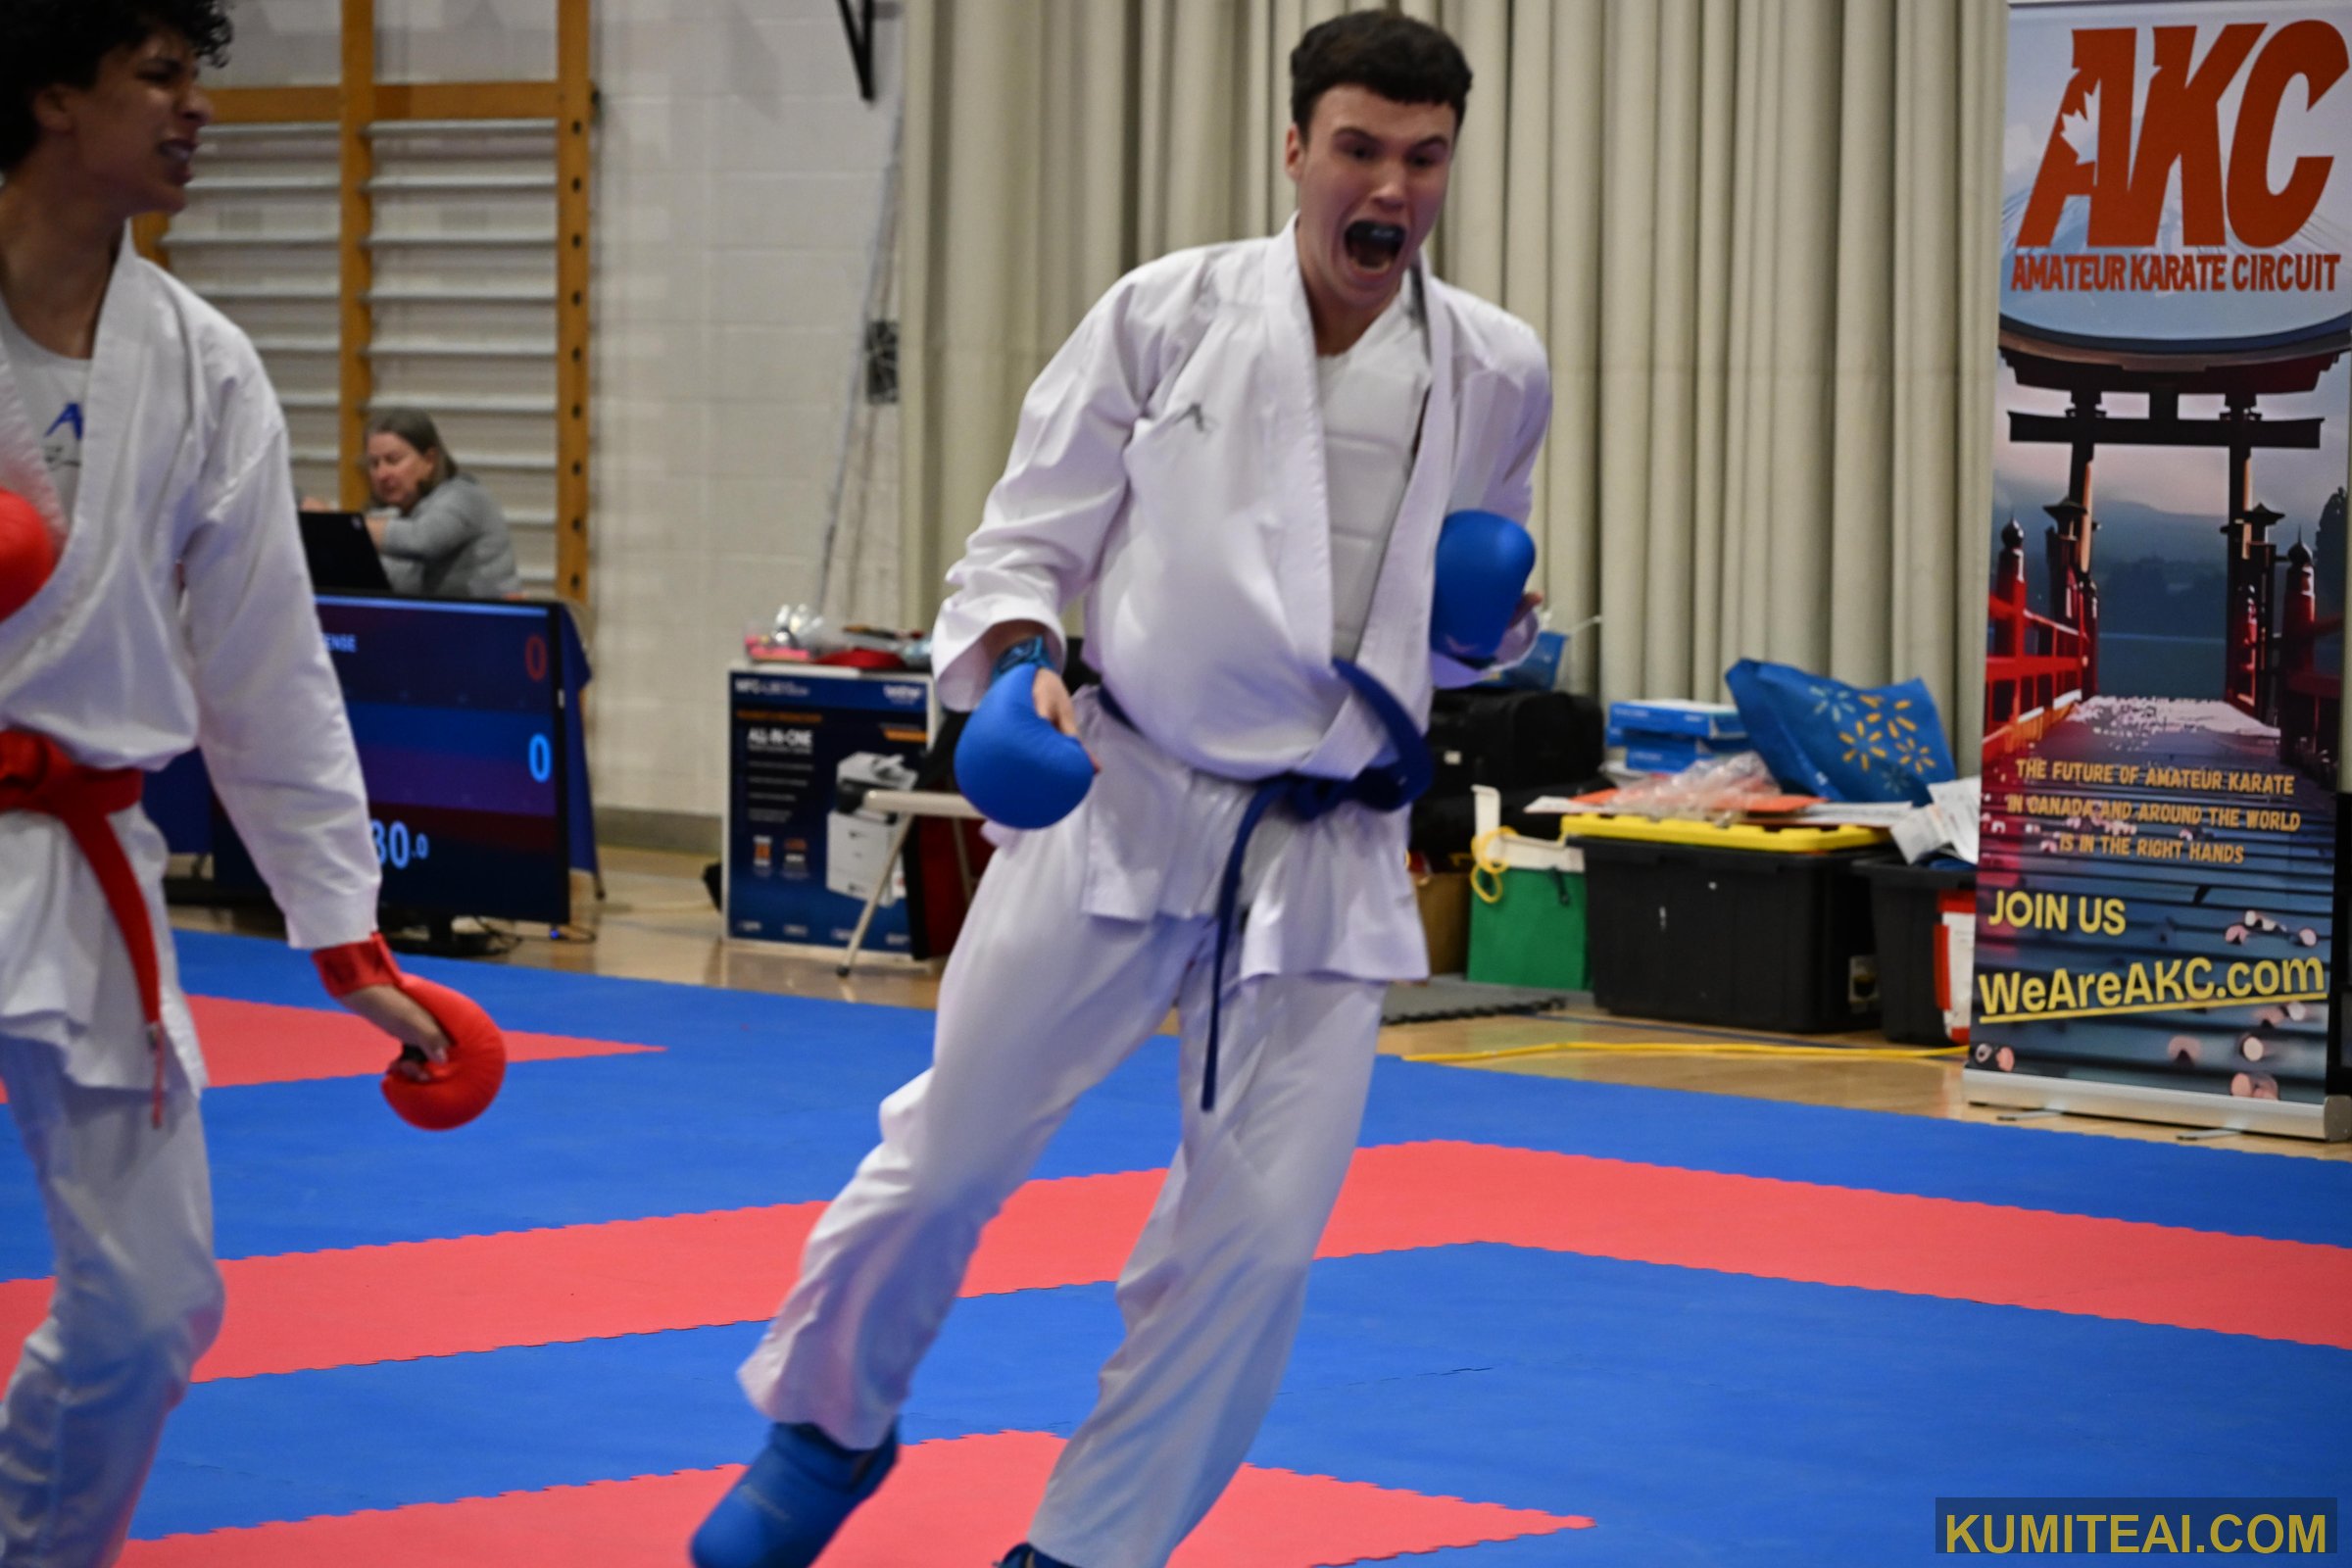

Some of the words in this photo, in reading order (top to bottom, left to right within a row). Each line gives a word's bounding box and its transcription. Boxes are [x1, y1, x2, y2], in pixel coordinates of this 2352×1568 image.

[2016, 20, 2349, 248] AKC
[2011, 254, 2127, 291] AMATEUR
[2130, 254, 2227, 291] KARATE
[2231, 254, 2341, 292] CIRCUIT
[524, 634, 548, 681] 0
[528, 732, 552, 782] 0
[2015, 758, 2047, 780] THE
[2052, 760, 2114, 783] FUTURE
[2119, 764, 2139, 784] OF
[2145, 767, 2223, 790] AMATEUR
[2229, 771, 2295, 795] KARATE
[2007, 794, 2024, 813] IN
[2027, 795, 2093, 817] CANADA
[2100, 798, 2132, 820] AND
[2136, 802, 2202, 825] AROUND
[2207, 806, 2240, 828] THE
[2246, 808, 2301, 832] WORLD
[2059, 834, 2076, 852] IS
[2079, 834, 2095, 854] IN
[2100, 836, 2131, 856] THE
[2136, 838, 2183, 859] RIGHT
[2188, 842, 2244, 863] HANDS
[1988, 890, 2068, 931] JOIN
[2079, 897, 2127, 936] US
[1979, 956, 2326, 1015] WeAreAKC.com
